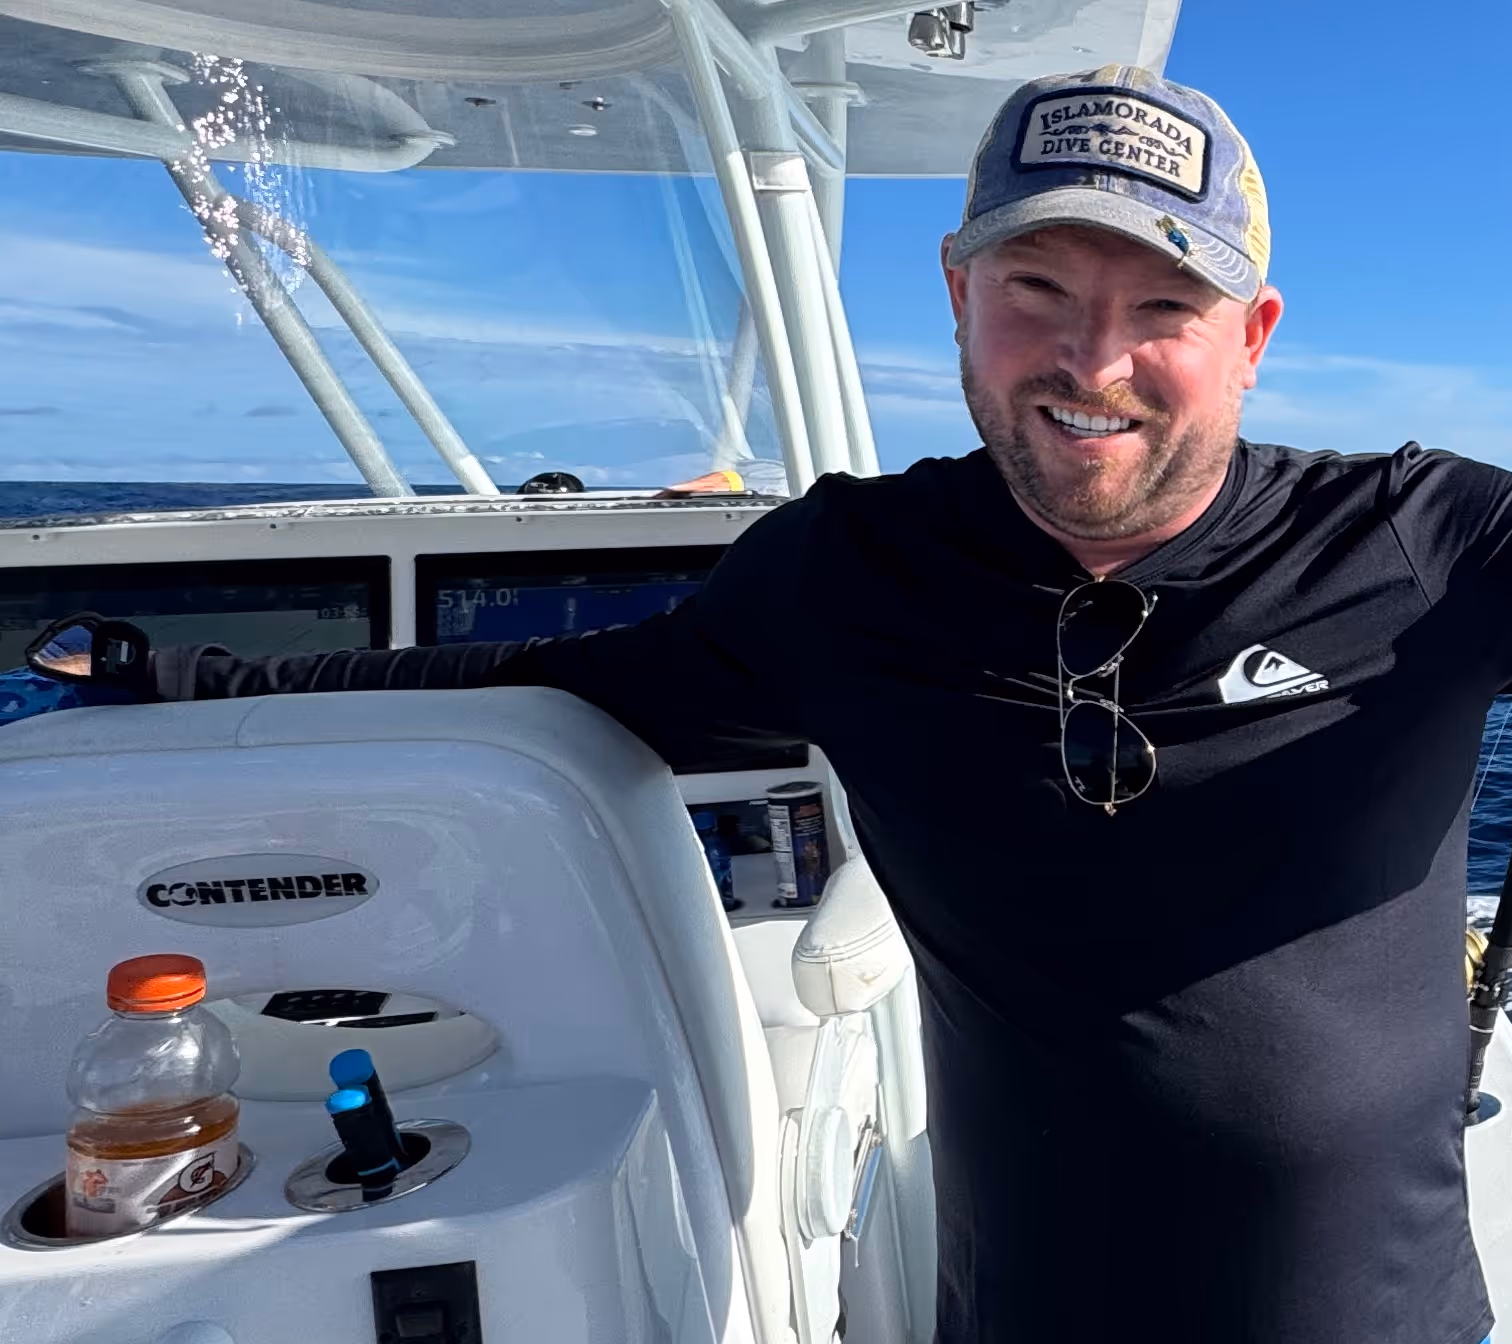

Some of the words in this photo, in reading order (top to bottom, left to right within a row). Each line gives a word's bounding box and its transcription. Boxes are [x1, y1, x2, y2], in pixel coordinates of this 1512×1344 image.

[1041, 100, 1193, 156] ISLAMORADA
[1041, 138, 1091, 156] DIVE
[1099, 139, 1181, 178] CENTER
[146, 872, 369, 908] CONTENDER
